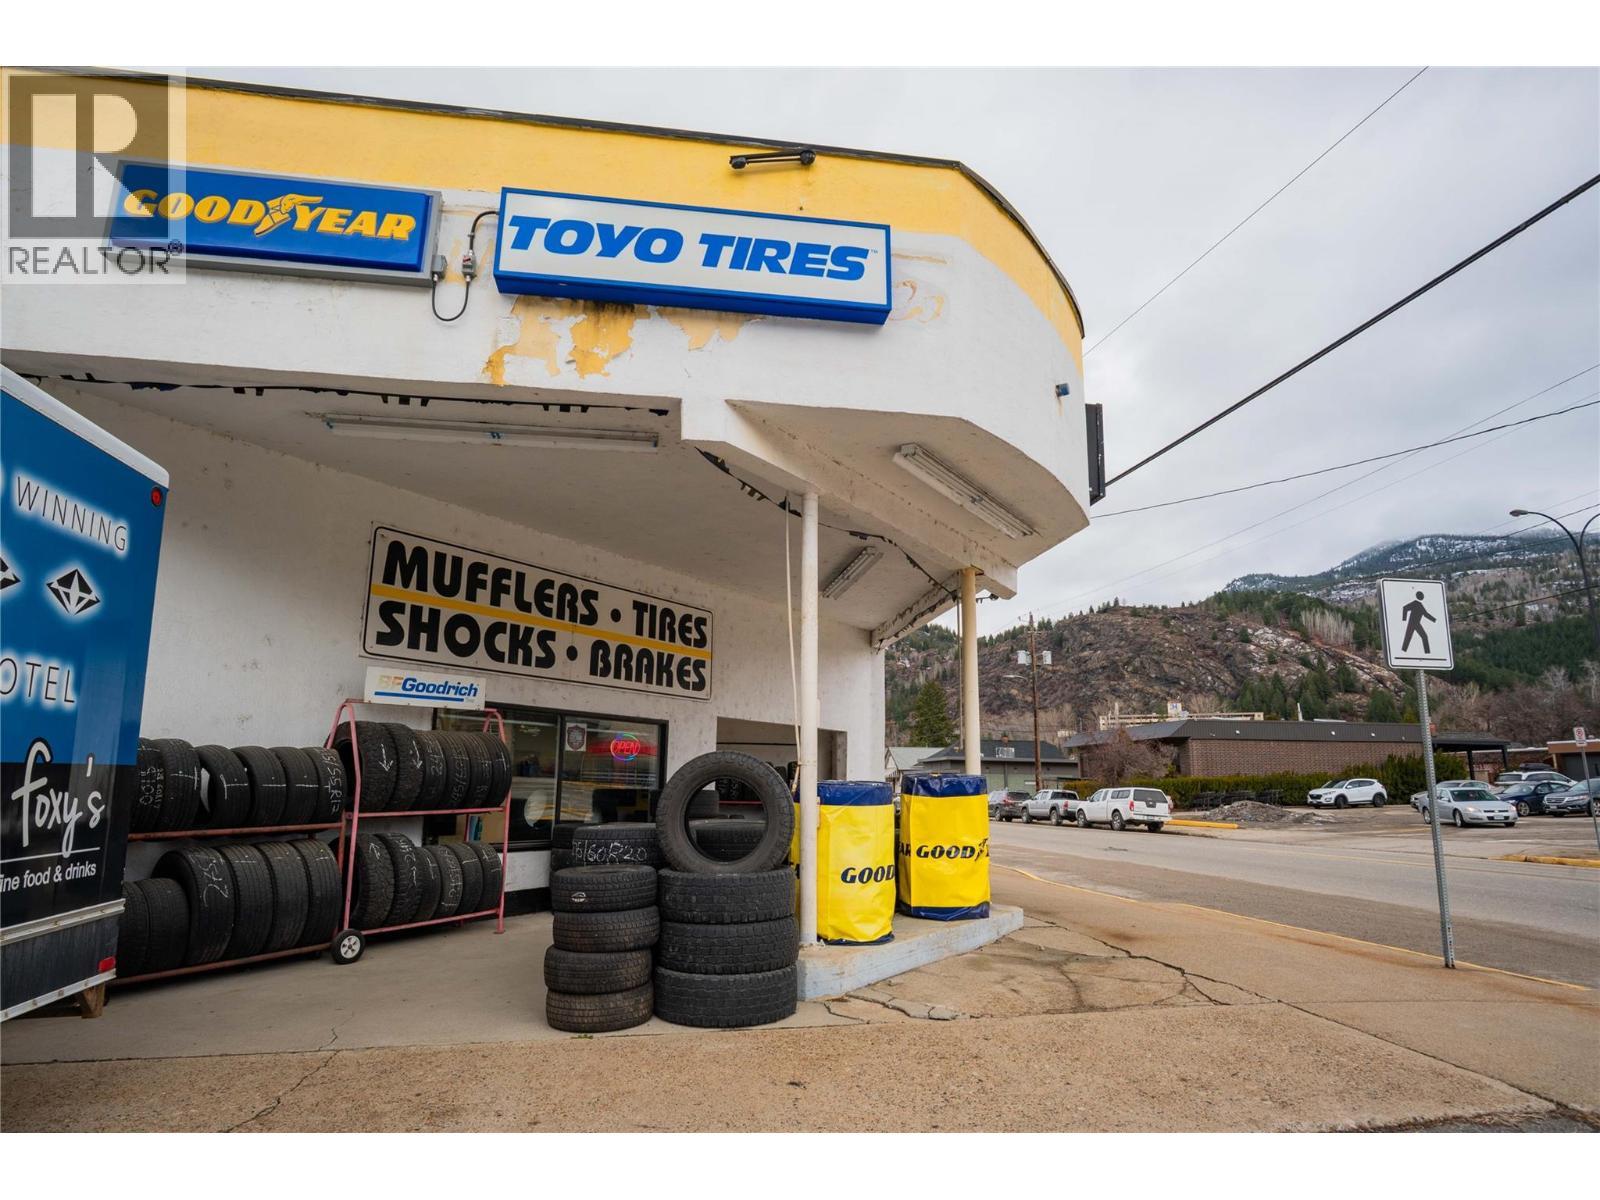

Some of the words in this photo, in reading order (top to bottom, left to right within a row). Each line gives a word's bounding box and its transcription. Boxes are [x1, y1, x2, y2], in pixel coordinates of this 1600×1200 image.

[508, 215, 684, 264] TOYO
[699, 233, 869, 281] TIRES
[17, 476, 127, 551] WINNING
[382, 540, 599, 626] MUFFLERS
[632, 600, 707, 648] TIRES
[376, 600, 556, 669] SHOCKS
[589, 639, 706, 692] BRAKES
[614, 740, 638, 755] OPEN
[23, 866, 51, 888] food
[53, 865, 62, 882] &
[65, 861, 97, 880] drinks
